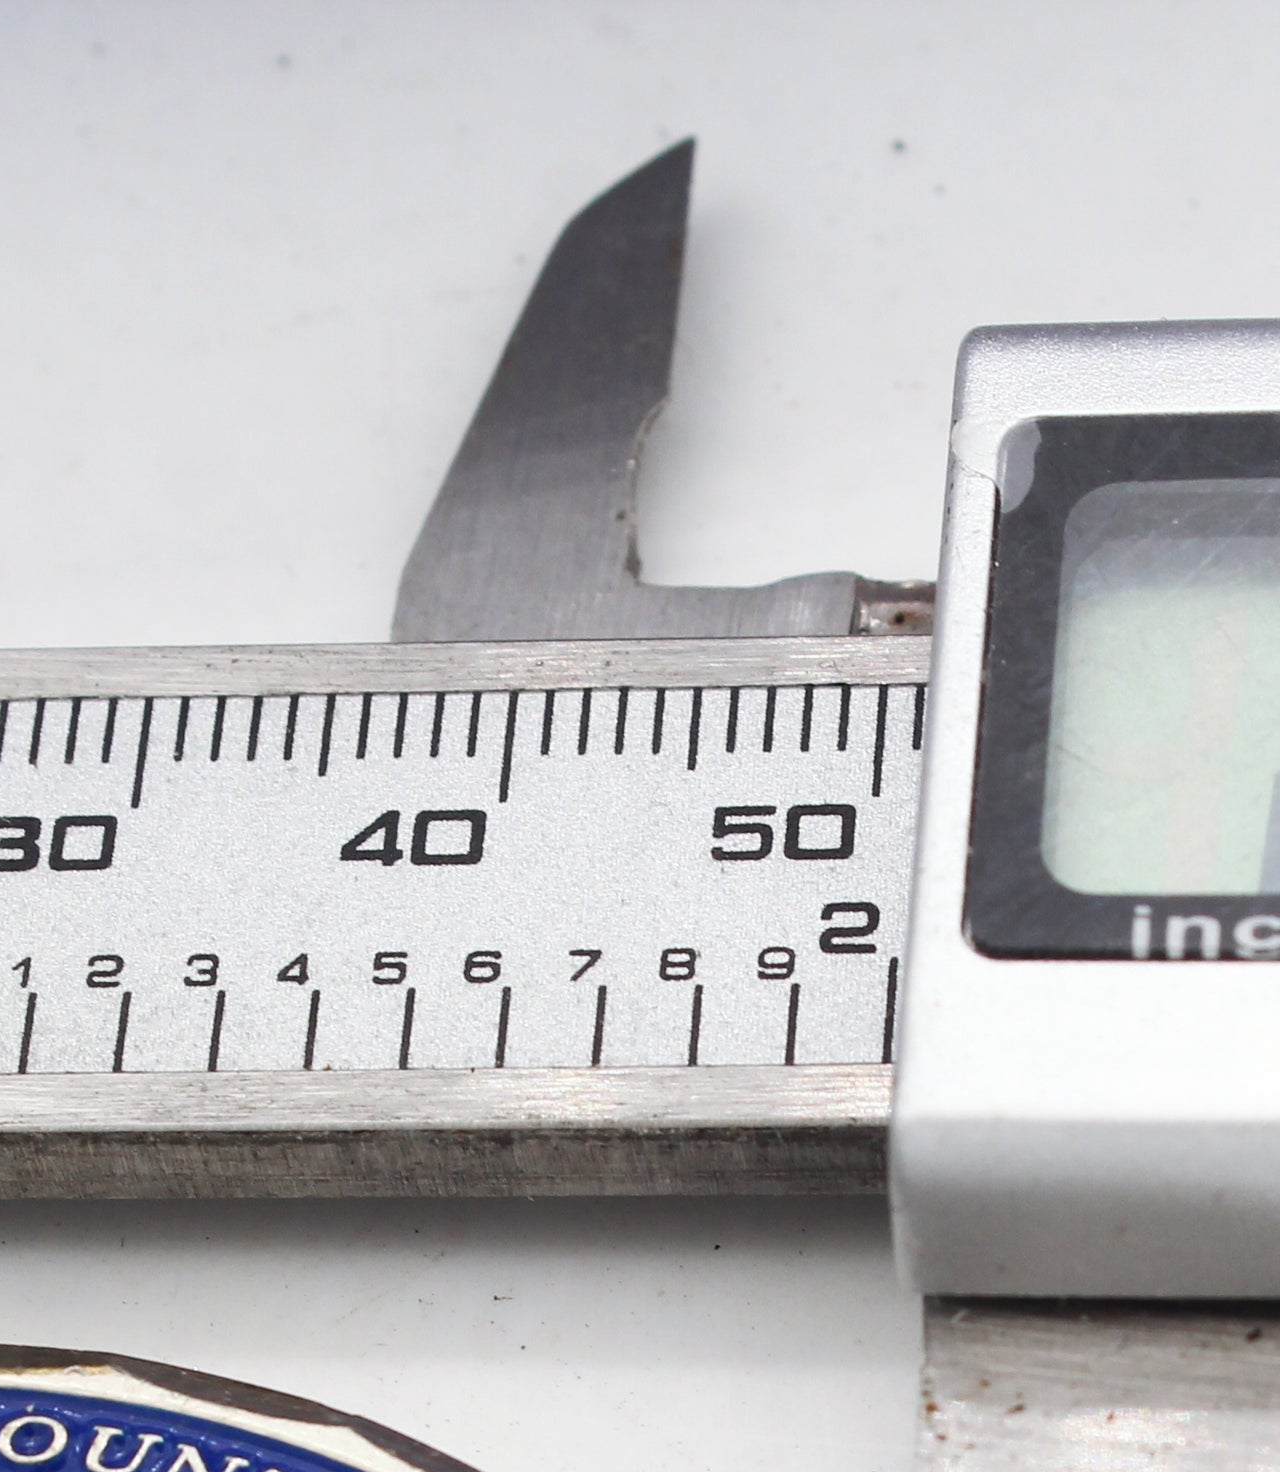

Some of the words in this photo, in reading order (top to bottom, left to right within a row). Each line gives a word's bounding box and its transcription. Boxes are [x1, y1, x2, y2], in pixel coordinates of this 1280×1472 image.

[340, 810, 487, 866] 40
[711, 804, 856, 861] 50
[12, 956, 32, 989] 1
[86, 954, 124, 988] 2
[183, 953, 220, 987] 3
[276, 953, 309, 986] 4
[372, 952, 408, 985] 5
[463, 950, 502, 984] 6
[569, 949, 603, 982] 7
[659, 948, 697, 982] 8
[757, 946, 796, 980] 9
[818, 901, 881, 955] 2
